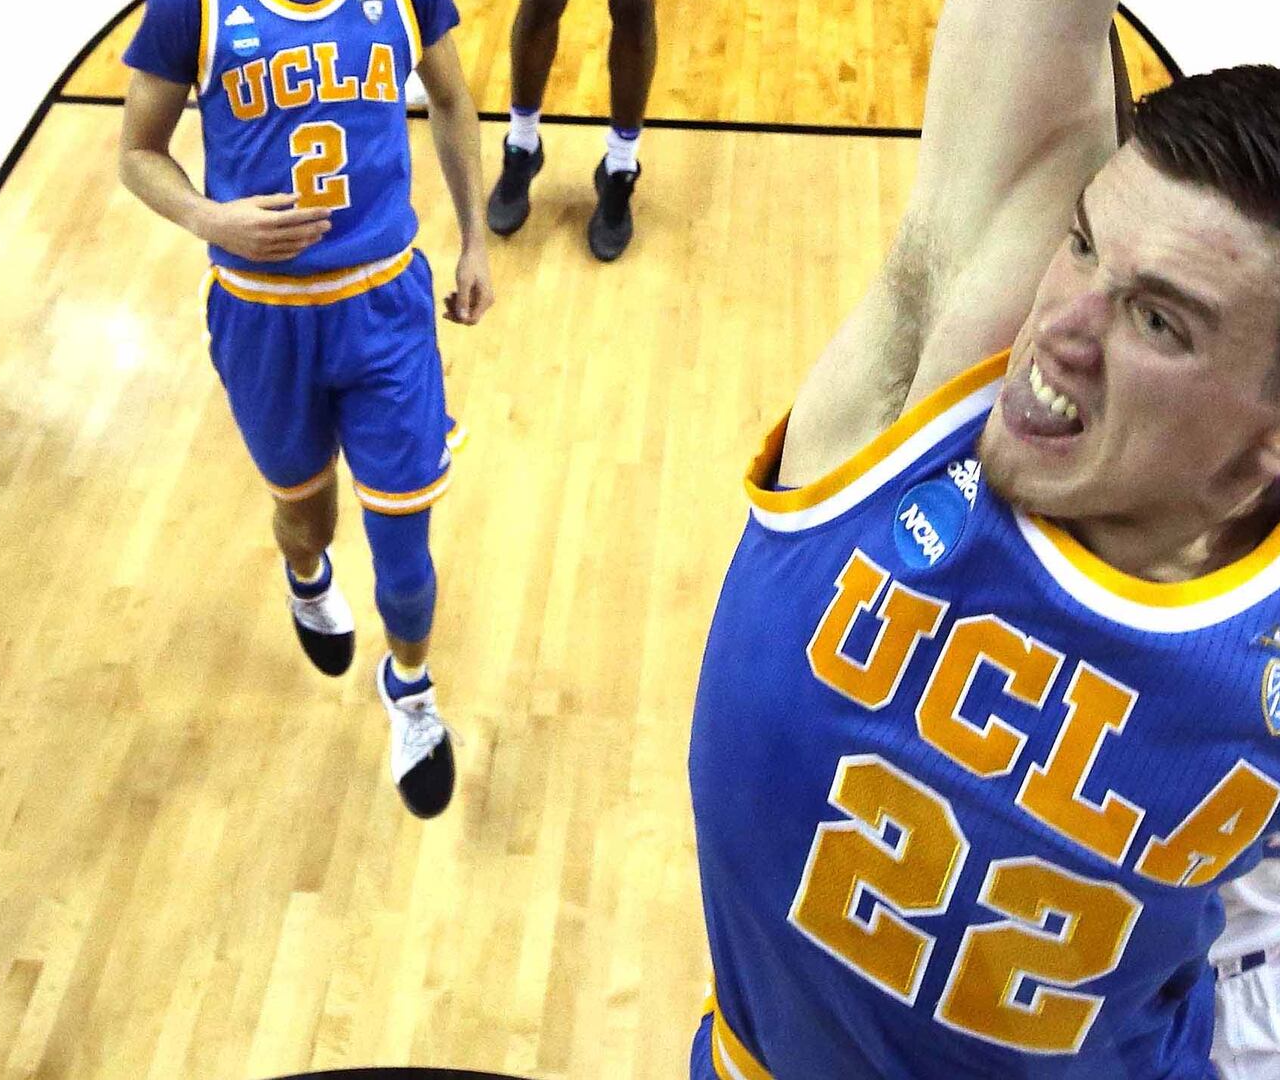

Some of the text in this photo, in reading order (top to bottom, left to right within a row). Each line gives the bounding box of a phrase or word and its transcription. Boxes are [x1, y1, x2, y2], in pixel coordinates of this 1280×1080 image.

[221, 41, 399, 120] UCLA
[289, 119, 352, 211] 2
[898, 502, 946, 568] NCAA
[786, 752, 1144, 1056] 22
